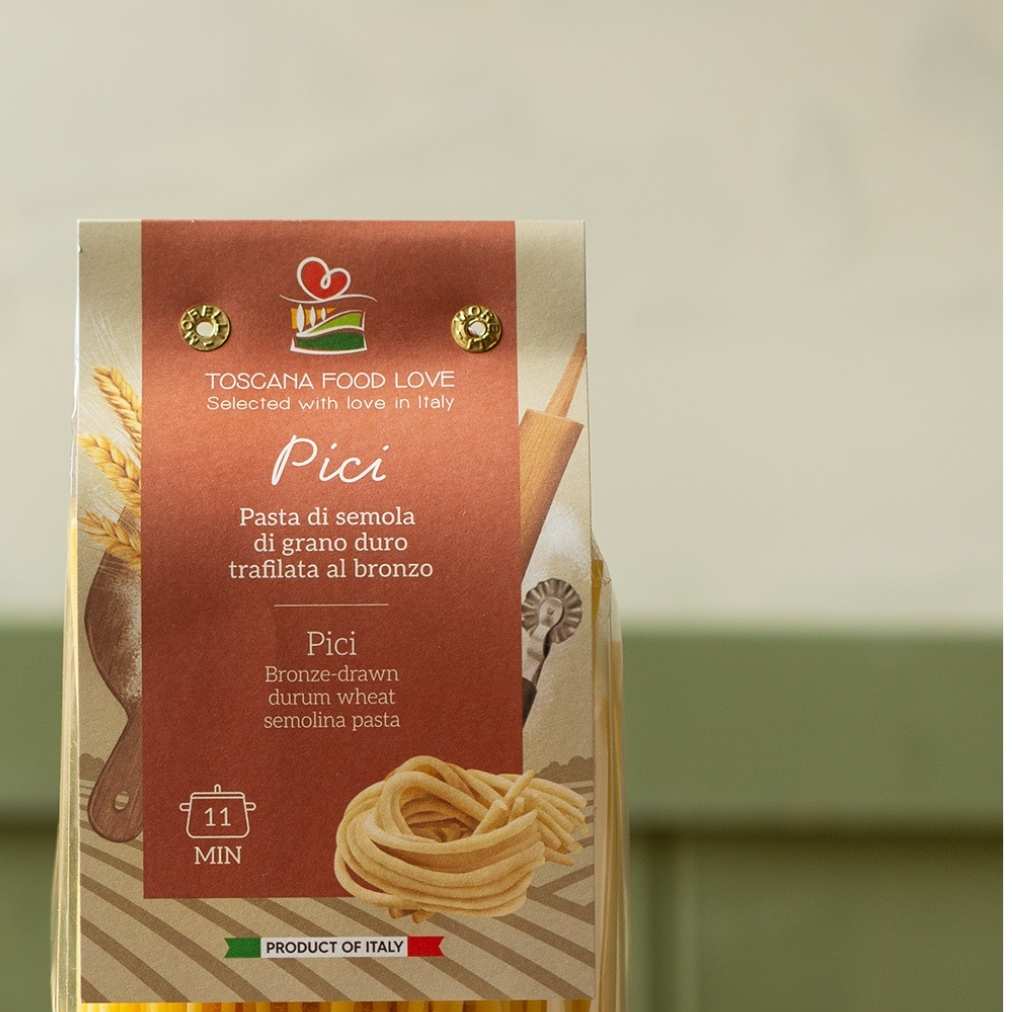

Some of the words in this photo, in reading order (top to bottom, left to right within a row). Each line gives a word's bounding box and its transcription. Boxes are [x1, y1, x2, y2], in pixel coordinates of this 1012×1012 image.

[205, 372, 315, 390] TOSCANA
[322, 371, 386, 390] FOOD
[394, 370, 455, 389] LOVE
[206, 395, 291, 411] Selected
[296, 395, 339, 411] with
[346, 395, 387, 411] love
[394, 394, 412, 410] in
[418, 394, 455, 412] Italy
[271, 434, 390, 486] Pici
[239, 507, 301, 527] Pasta
[307, 506, 329, 526] di
[335, 506, 416, 526] semola
[253, 532, 275, 553] di
[281, 537, 348, 557] grano
[354, 531, 408, 552] duro
[228, 558, 320, 579] trafilata
[326, 558, 347, 578] al
[353, 558, 434, 578] bronzo
[306, 630, 357, 656] Pici
[264, 664, 399, 683] Bronze-drawn
[268, 688, 331, 706] durum
[336, 687, 396, 705] wheat
[263, 711, 346, 729] semolina
[351, 709, 402, 732] pasta
[204, 807, 232, 827] 11
[194, 845, 242, 865] MIN
[266, 940, 338, 954] PRODUCT
[341, 940, 362, 954] OF
[365, 940, 404, 953] ITALY
